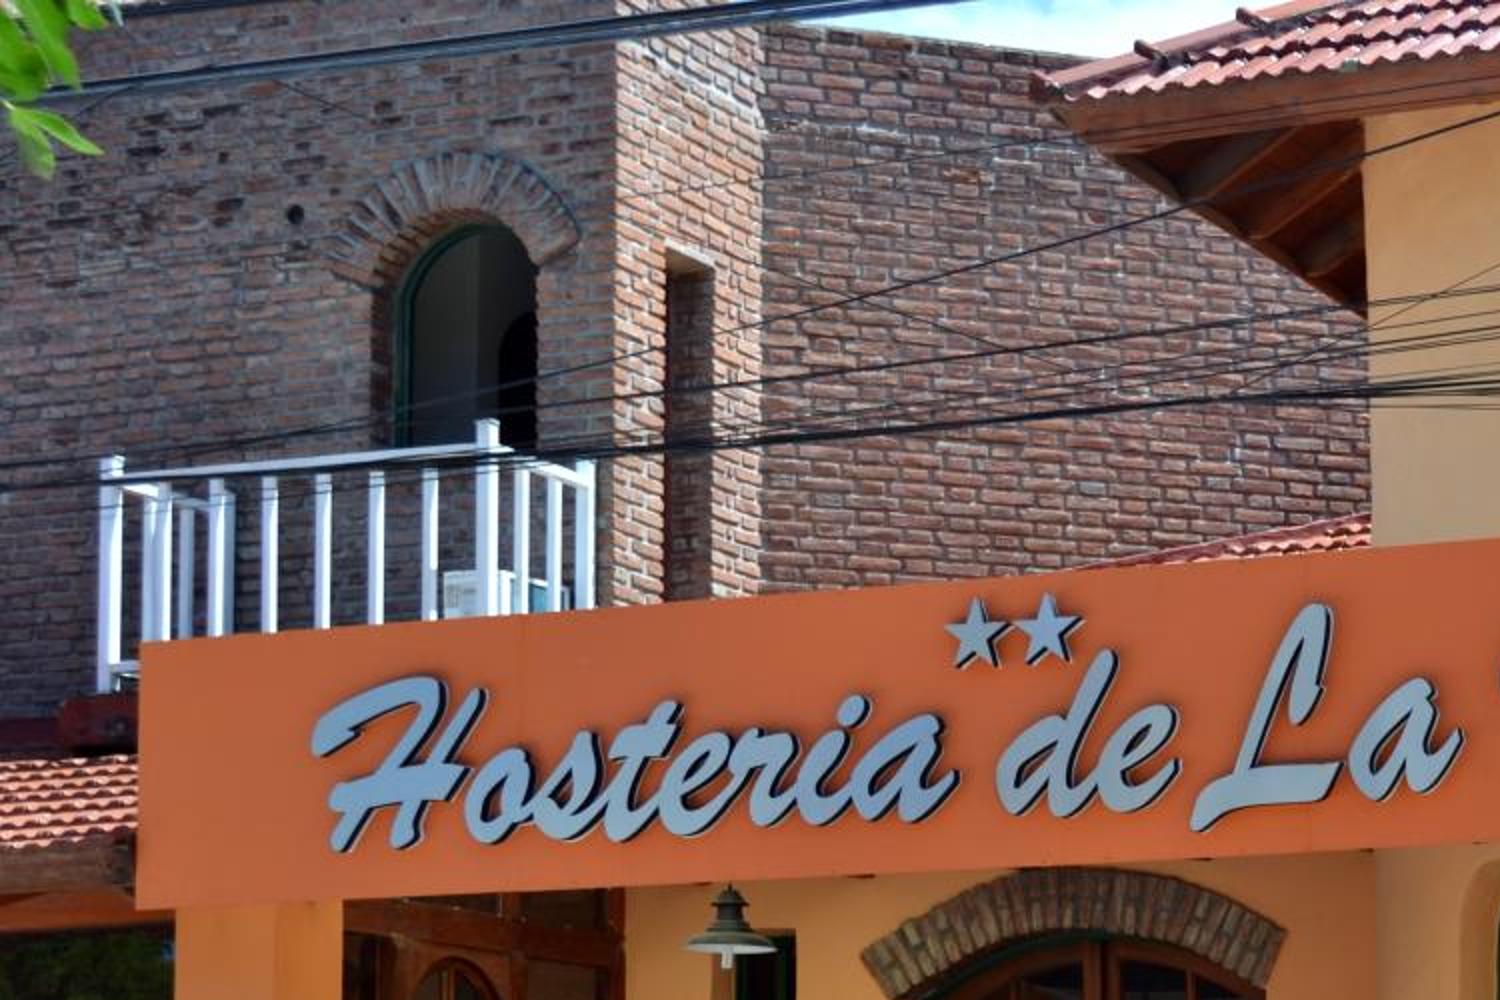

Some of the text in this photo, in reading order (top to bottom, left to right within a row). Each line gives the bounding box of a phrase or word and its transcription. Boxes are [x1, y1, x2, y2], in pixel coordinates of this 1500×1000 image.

[311, 675, 960, 853] Hosteria
[996, 649, 1182, 816] de
[1190, 602, 1465, 833] La
